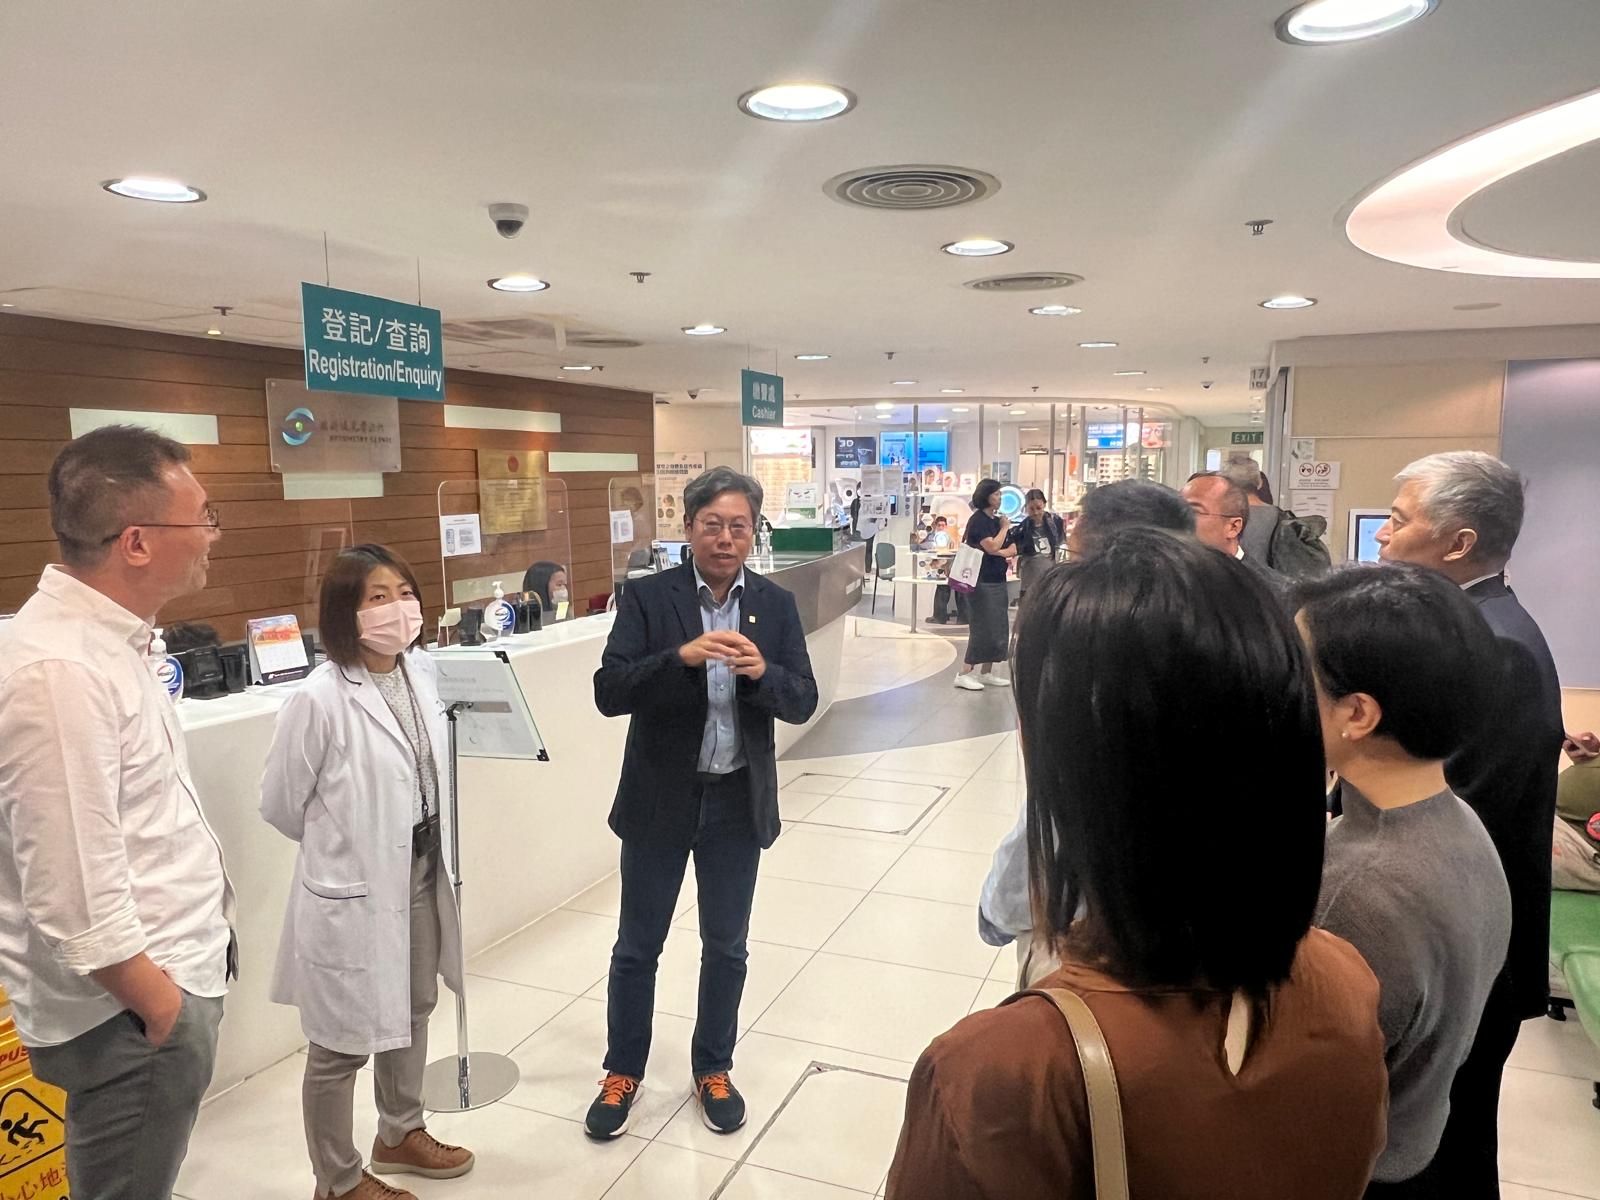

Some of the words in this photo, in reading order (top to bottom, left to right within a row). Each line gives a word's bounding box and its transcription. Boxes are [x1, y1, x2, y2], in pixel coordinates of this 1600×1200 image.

[321, 307, 431, 355] 登記/查詢
[308, 348, 442, 392] Registration/Enquiry
[752, 405, 776, 420] Cashier
[1234, 433, 1256, 443] EXIT
